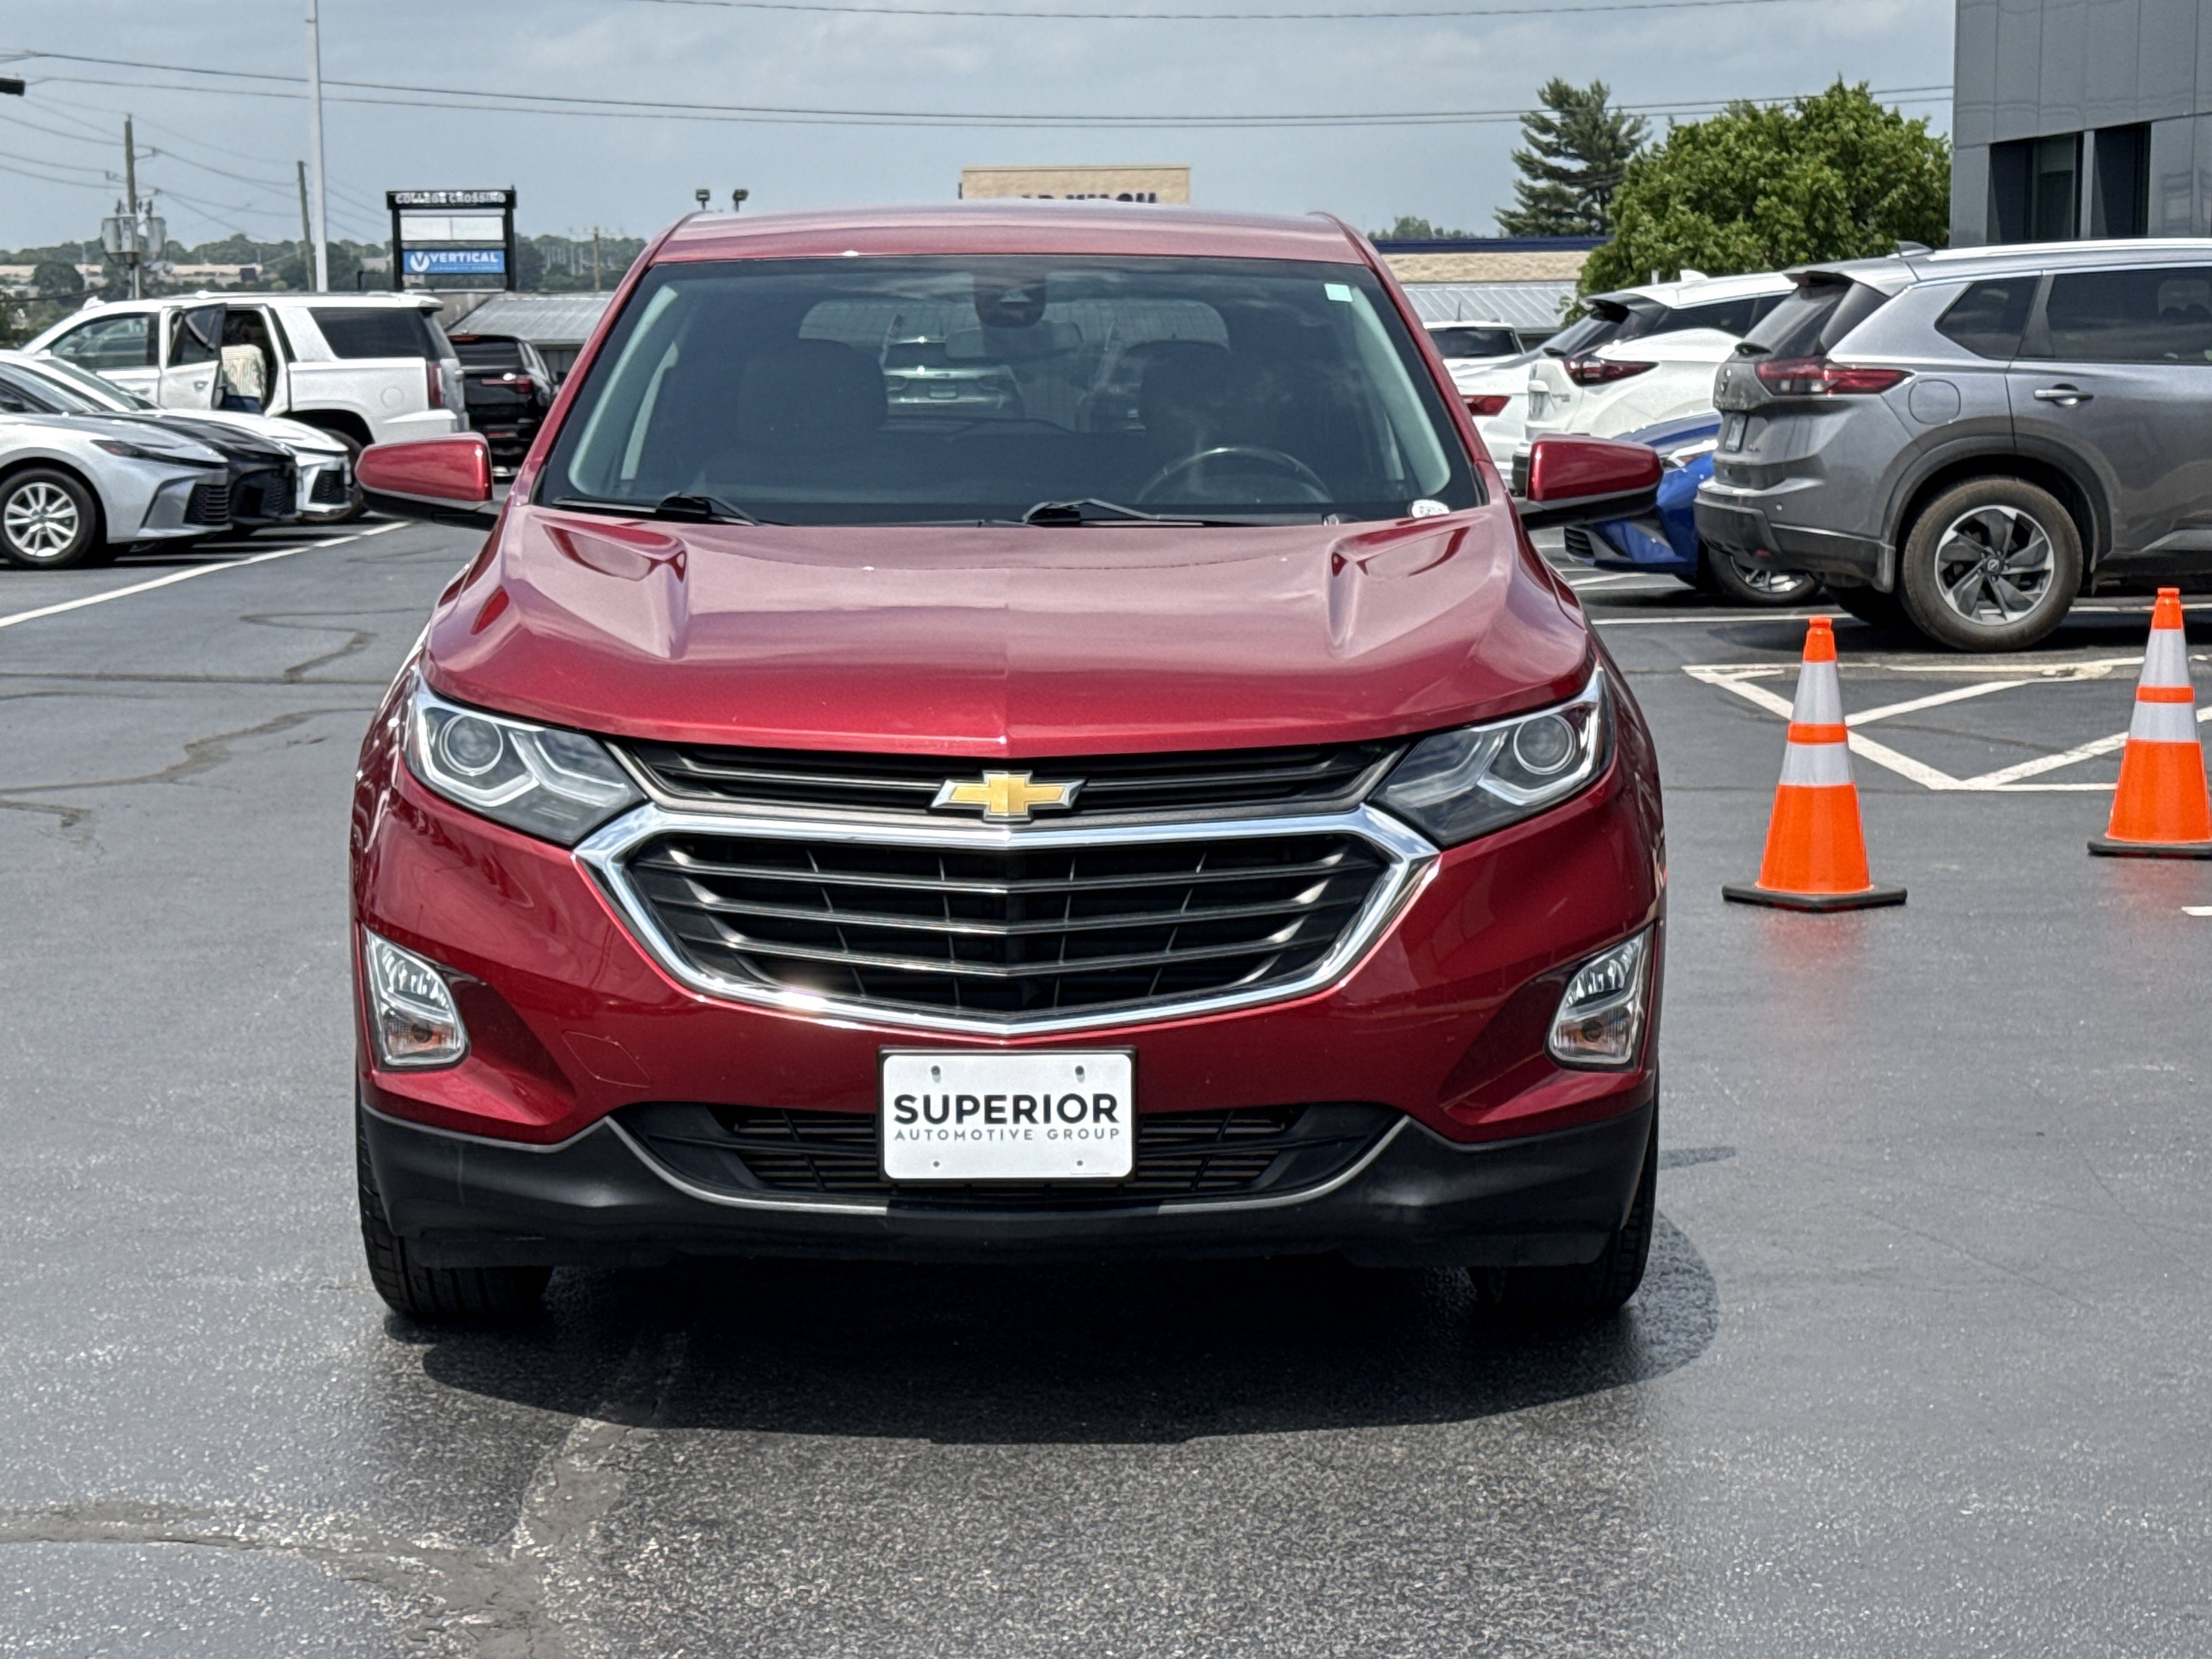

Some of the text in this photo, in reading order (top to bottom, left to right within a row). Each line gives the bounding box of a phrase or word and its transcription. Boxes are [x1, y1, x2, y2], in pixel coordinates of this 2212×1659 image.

[429, 251, 498, 263] VERTICAL
[894, 1093, 1119, 1125] SUPERIOR
[894, 1128, 1120, 1141] AUTOMOTIVE GROUP
